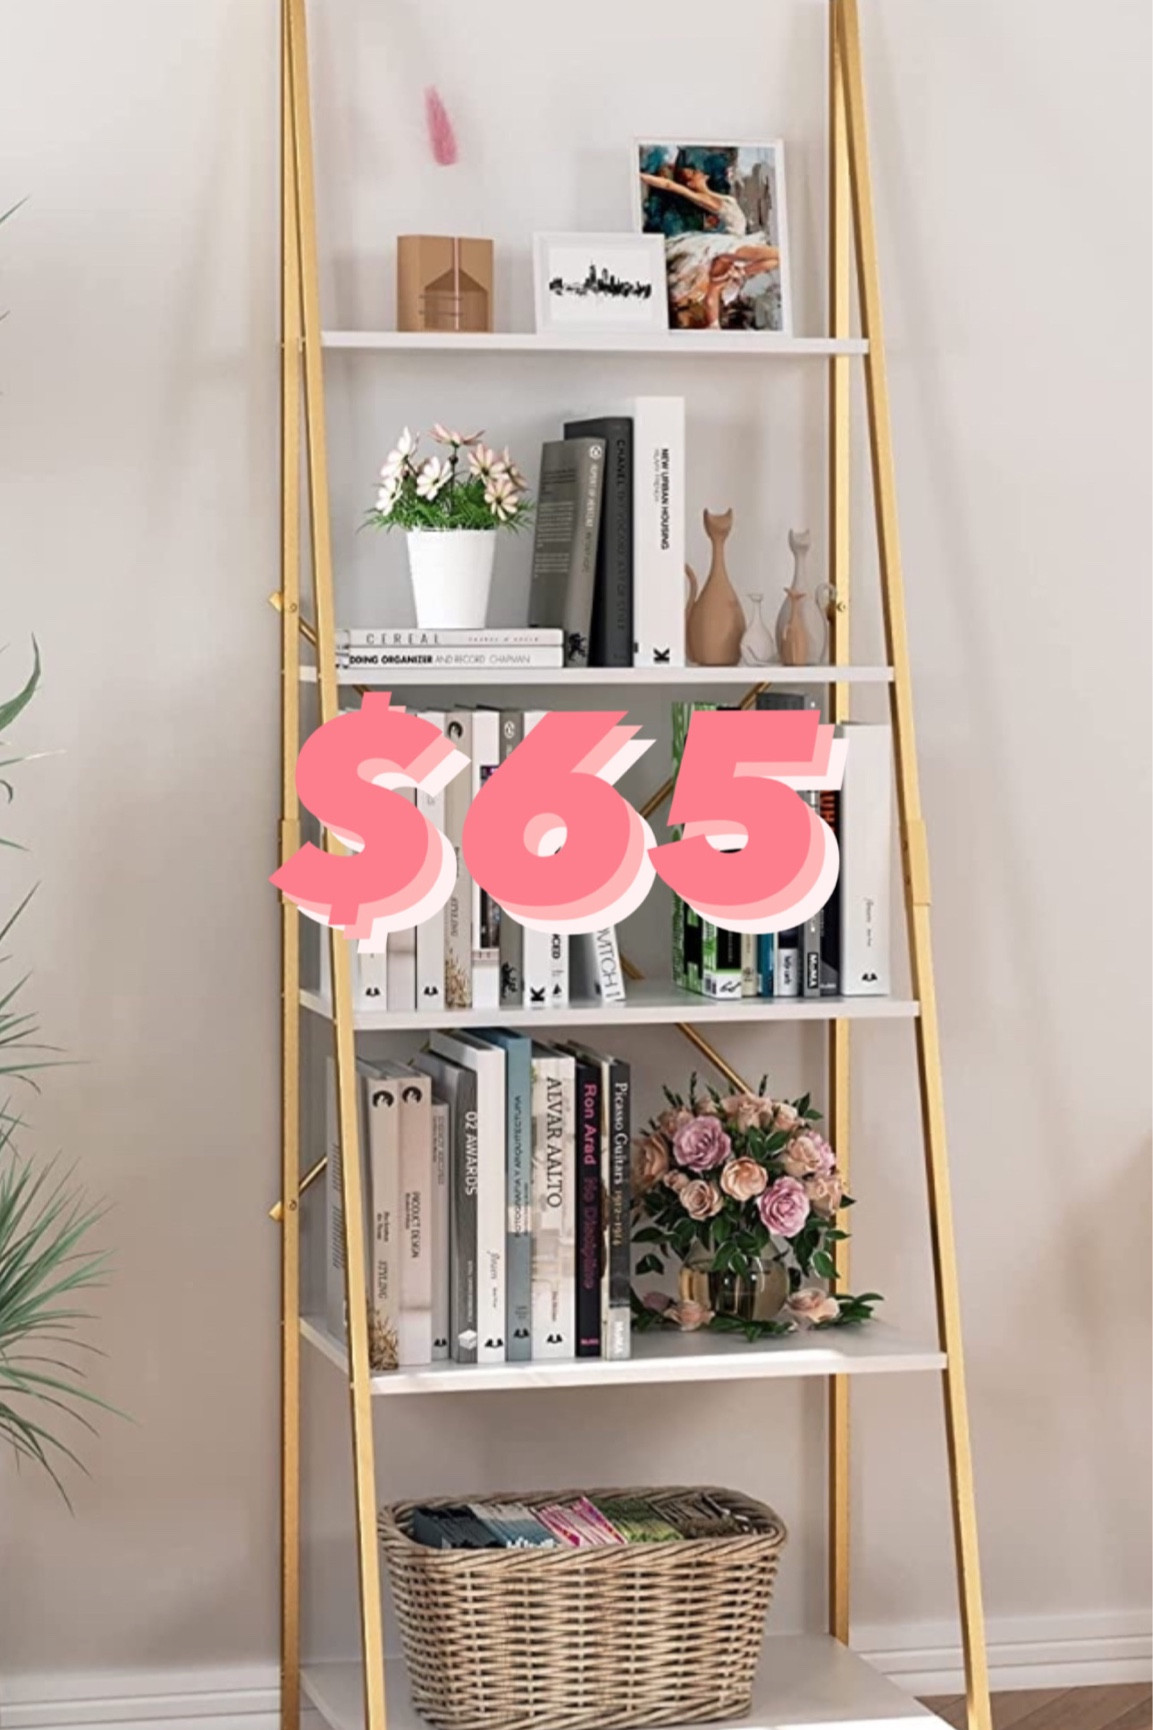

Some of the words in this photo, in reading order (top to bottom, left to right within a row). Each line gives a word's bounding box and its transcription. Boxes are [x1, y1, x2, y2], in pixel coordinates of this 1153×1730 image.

[616, 439, 627, 487] CHANEL
[660, 448, 670, 469] NEW
[660, 471, 670, 504] URBAN
[660, 506, 670, 551] HOUSING
[366, 633, 440, 645] CEREAL
[653, 647, 671, 663] K
[381, 655, 433, 665] ORGANIZER
[546, 1076, 563, 1147] ALVAR
[583, 1083, 598, 1118] Ron
[614, 1082, 628, 1130] Picasso
[583, 1120, 598, 1166] Arad
[614, 1132, 629, 1185] Guitars
[465, 1133, 478, 1196] AWARDS
[546, 1150, 563, 1209] AALTO
[411, 1191, 421, 1227] PRODUCT
[410, 1229, 421, 1258] DESIGN
